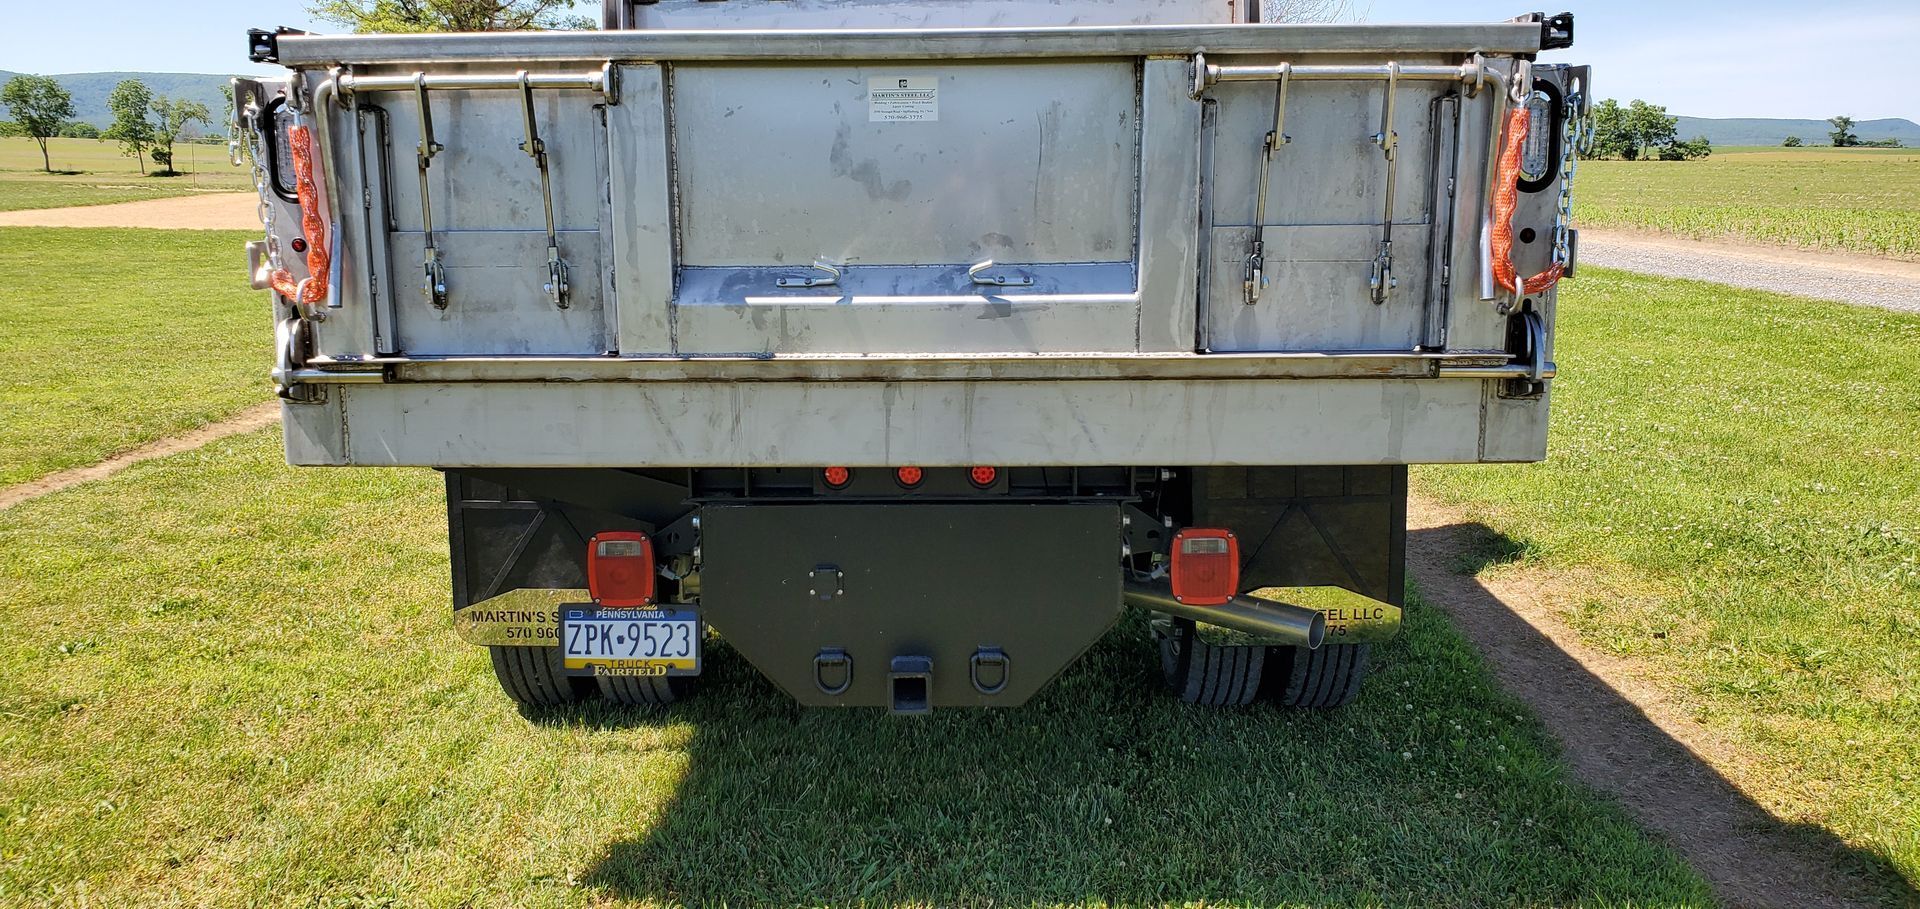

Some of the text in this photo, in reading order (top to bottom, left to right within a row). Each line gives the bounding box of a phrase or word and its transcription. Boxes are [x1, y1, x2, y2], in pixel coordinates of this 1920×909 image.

[471, 610, 546, 623] MARTIN'S
[596, 610, 665, 619] PENNSYLVANIA
[1353, 607, 1384, 620] LLC
[506, 627, 532, 639] 570
[593, 664, 667, 676] FAIRFIELD
[609, 659, 651, 669] TRUCK
